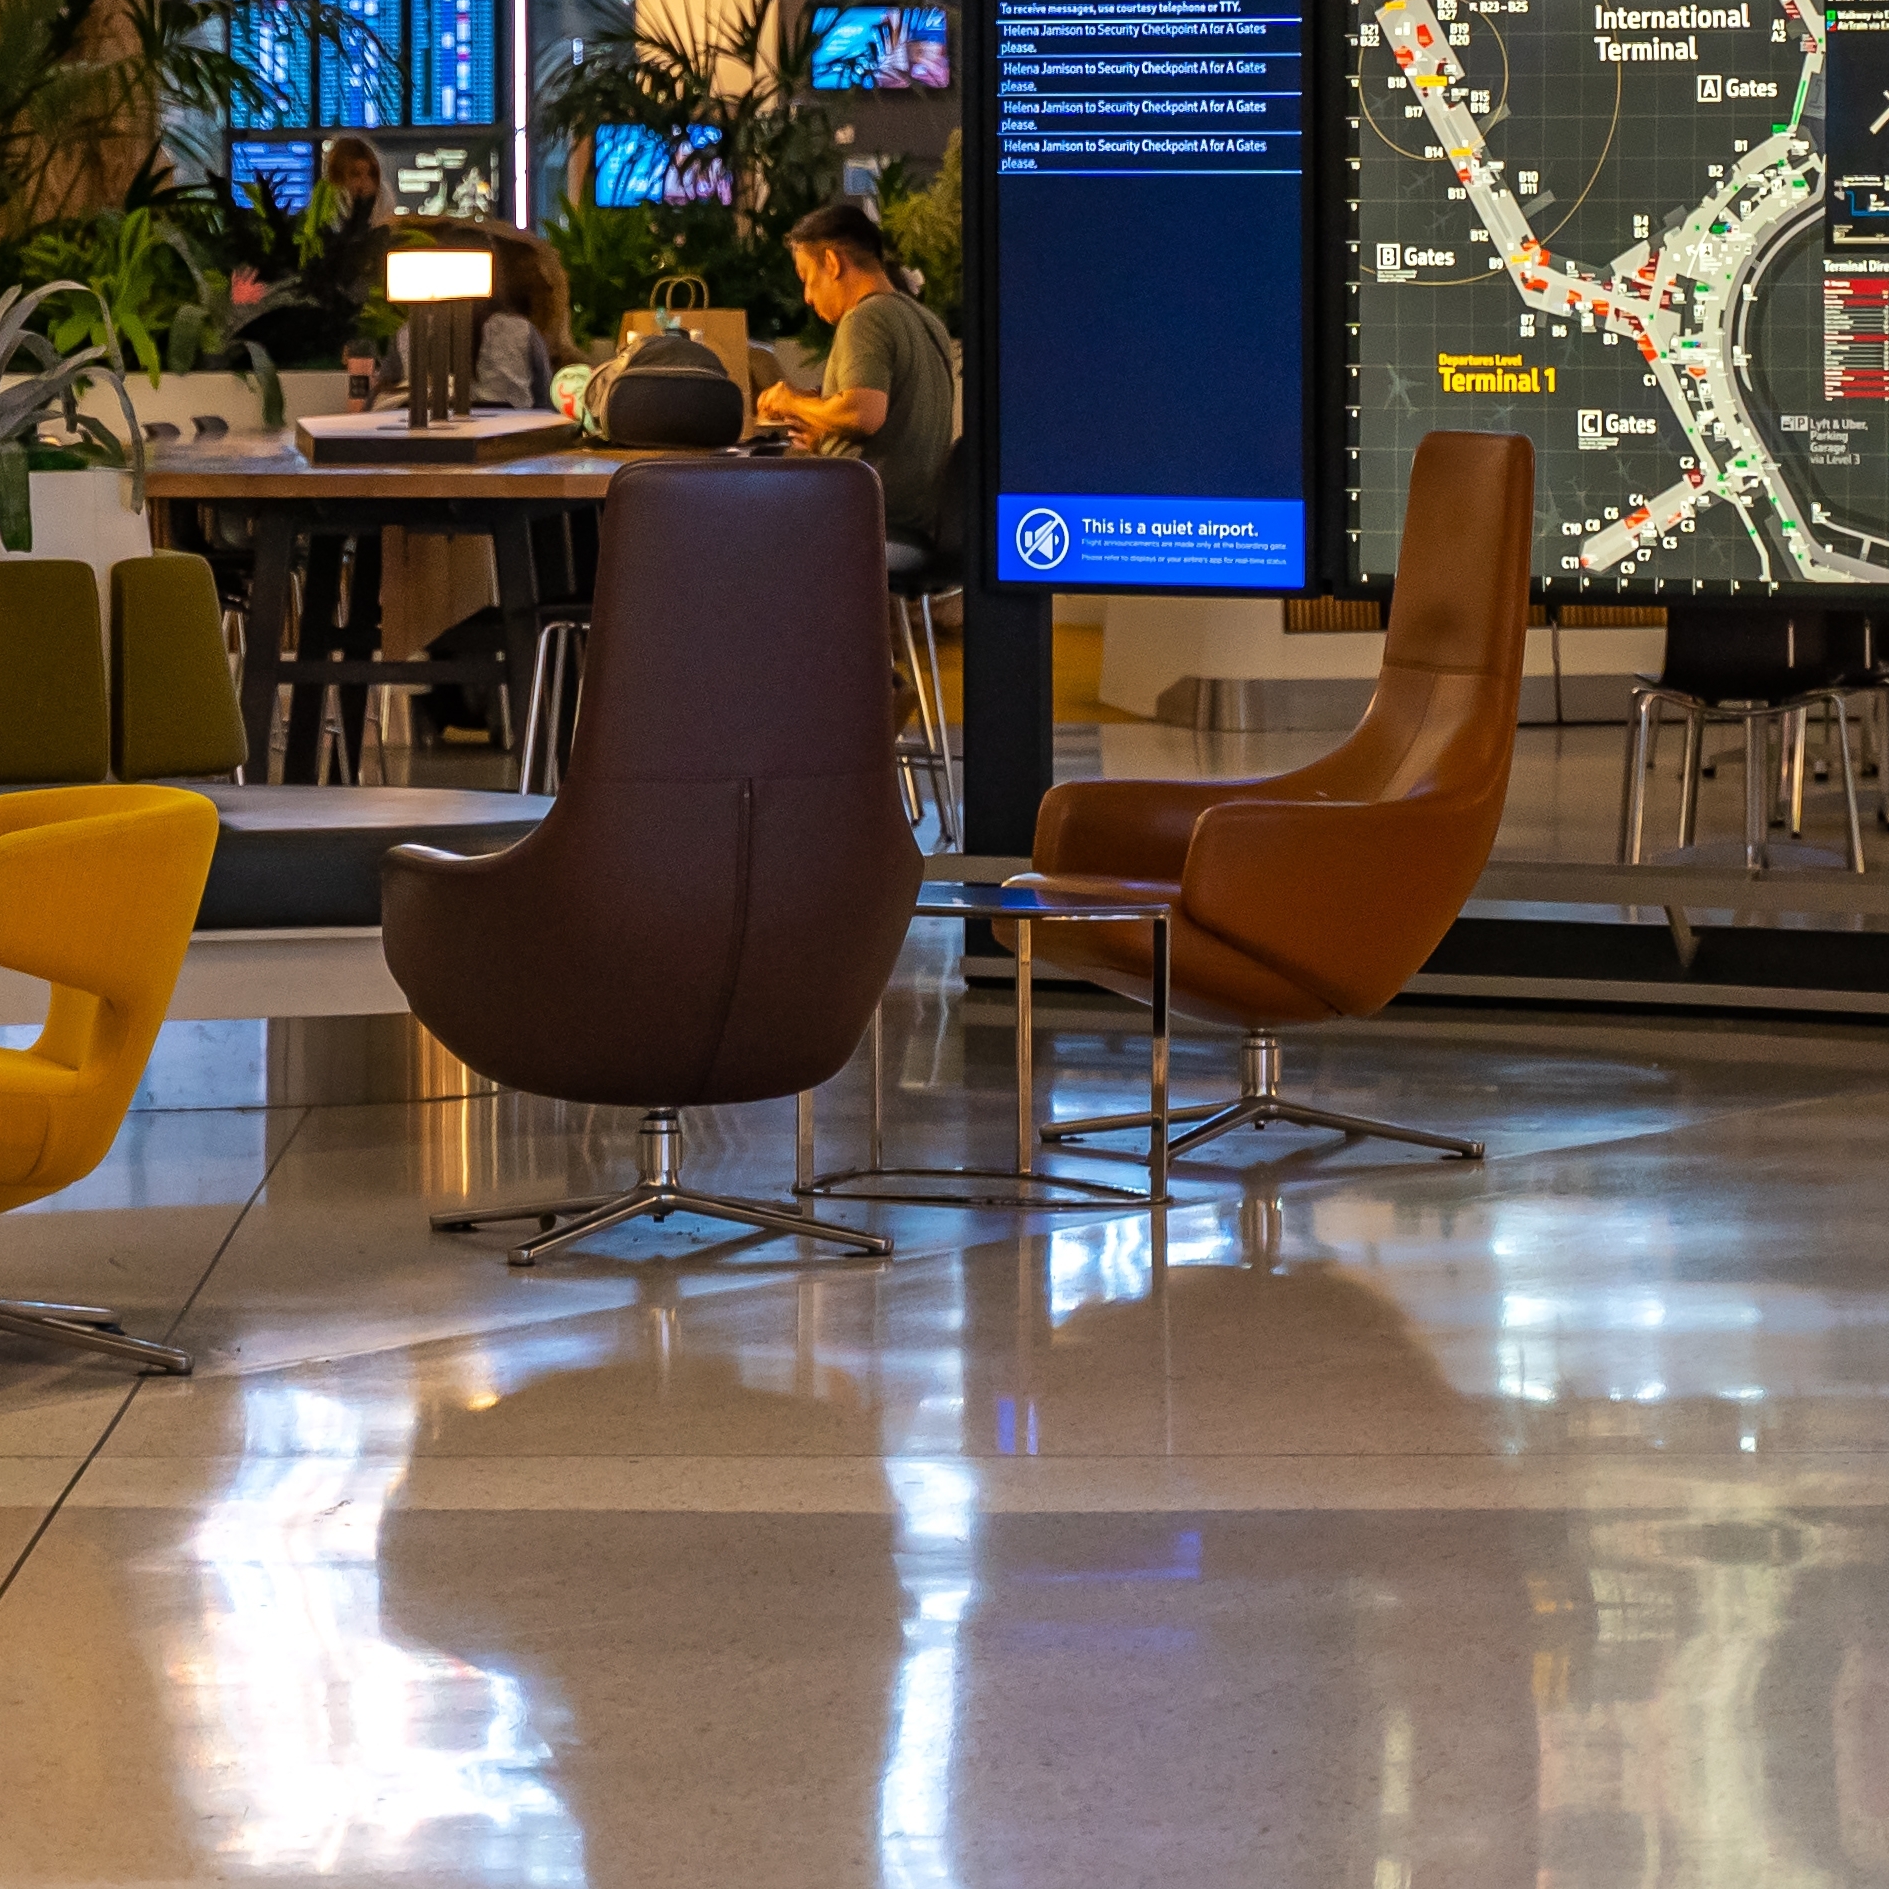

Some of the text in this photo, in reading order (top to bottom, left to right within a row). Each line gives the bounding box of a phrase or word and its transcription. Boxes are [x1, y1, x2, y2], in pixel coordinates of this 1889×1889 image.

[1001, 1, 1241, 16] To receive messages, use courtesy telephone or TTY.
[1595, 3, 1750, 29] International
[1004, 24, 1266, 38] Helena Jamison to Security Checkpoint A for A Gates
[1002, 42, 1037, 55] please.
[1594, 36, 1698, 61] Terminal
[1004, 62, 1266, 76] Helena Jamison to Security Checkpoint A for A Gates
[1002, 81, 1037, 93] please.
[1703, 78, 1777, 98] A Gates
[1382, 248, 1455, 266] B Gates
[1823, 260, 1867, 272] Terminal
[1439, 367, 1555, 392] Terminal 1
[1583, 414, 1656, 433] C Gates
[1810, 431, 1848, 443] Parking
[1082, 519, 1258, 539] This is a quiet airport.
